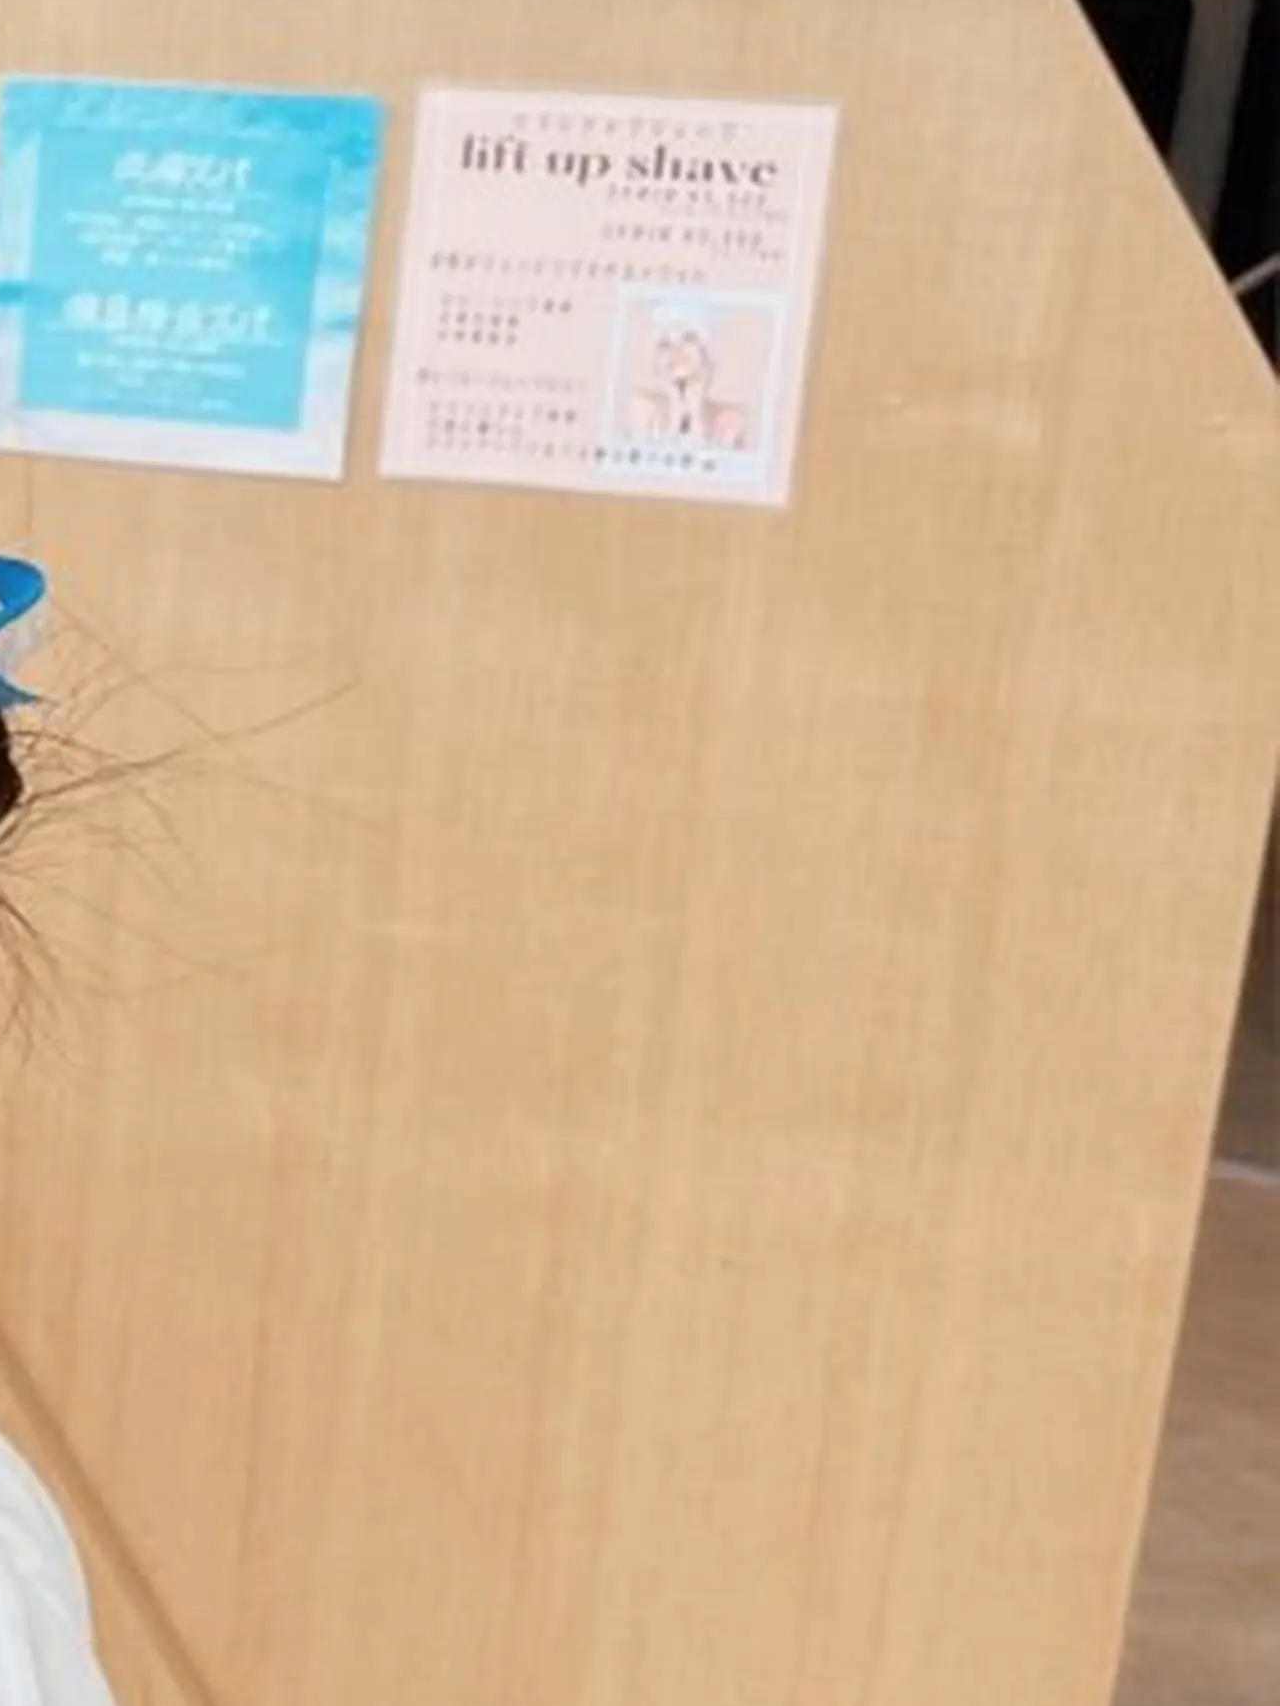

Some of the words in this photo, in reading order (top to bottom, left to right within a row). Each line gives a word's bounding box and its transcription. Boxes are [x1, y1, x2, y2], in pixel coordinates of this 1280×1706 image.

[461, 132, 528, 174] lift
[546, 152, 612, 188] up
[624, 144, 779, 188] shave
